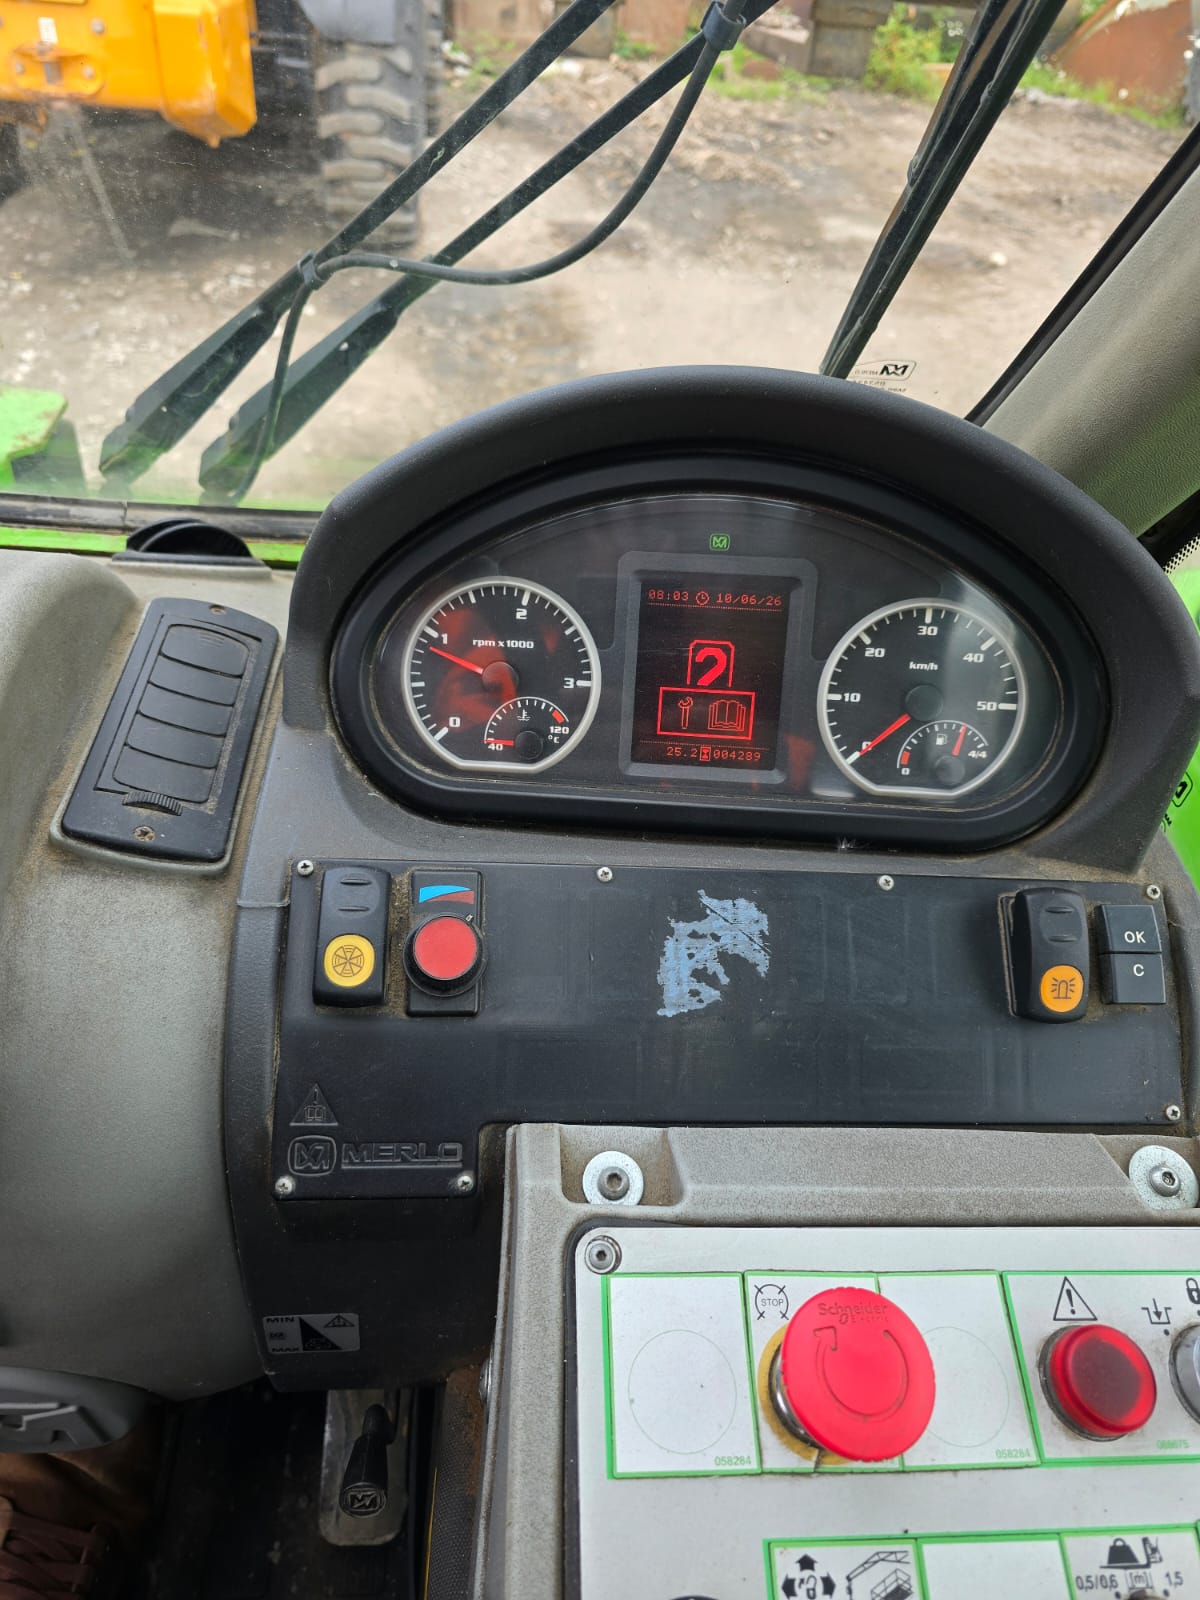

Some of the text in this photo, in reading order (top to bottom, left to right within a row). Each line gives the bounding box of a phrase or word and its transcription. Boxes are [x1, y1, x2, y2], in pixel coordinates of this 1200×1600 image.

[648, 589, 782, 606] 08:03 10/06/26
[515, 608, 527, 620] 2
[917, 625, 938, 636] 30
[441, 633, 448, 645] 1
[472, 638, 496, 648] rpm
[864, 647, 885, 658] 20
[962, 652, 984, 663] 40
[909, 661, 938, 671] km/h
[563, 677, 575, 689] 3
[843, 692, 861, 703] 10
[976, 701, 997, 711] 50
[449, 716, 461, 728] 0
[549, 726, 570, 734] 120
[487, 743, 504, 751] 40
[666, 746, 761, 761] 25.2 004289
[967, 750, 988, 759] 4/4
[901, 767, 910, 776] 0
[1124, 931, 1146, 944] OK
[1133, 963, 1145, 977] C
[341, 1142, 463, 1163] MERLO
[760, 1298, 784, 1307] STOP
[817, 1302, 888, 1316] Schneider
[714, 1455, 752, 1466] 058284
[1165, 1571, 1184, 1588] 1,5
